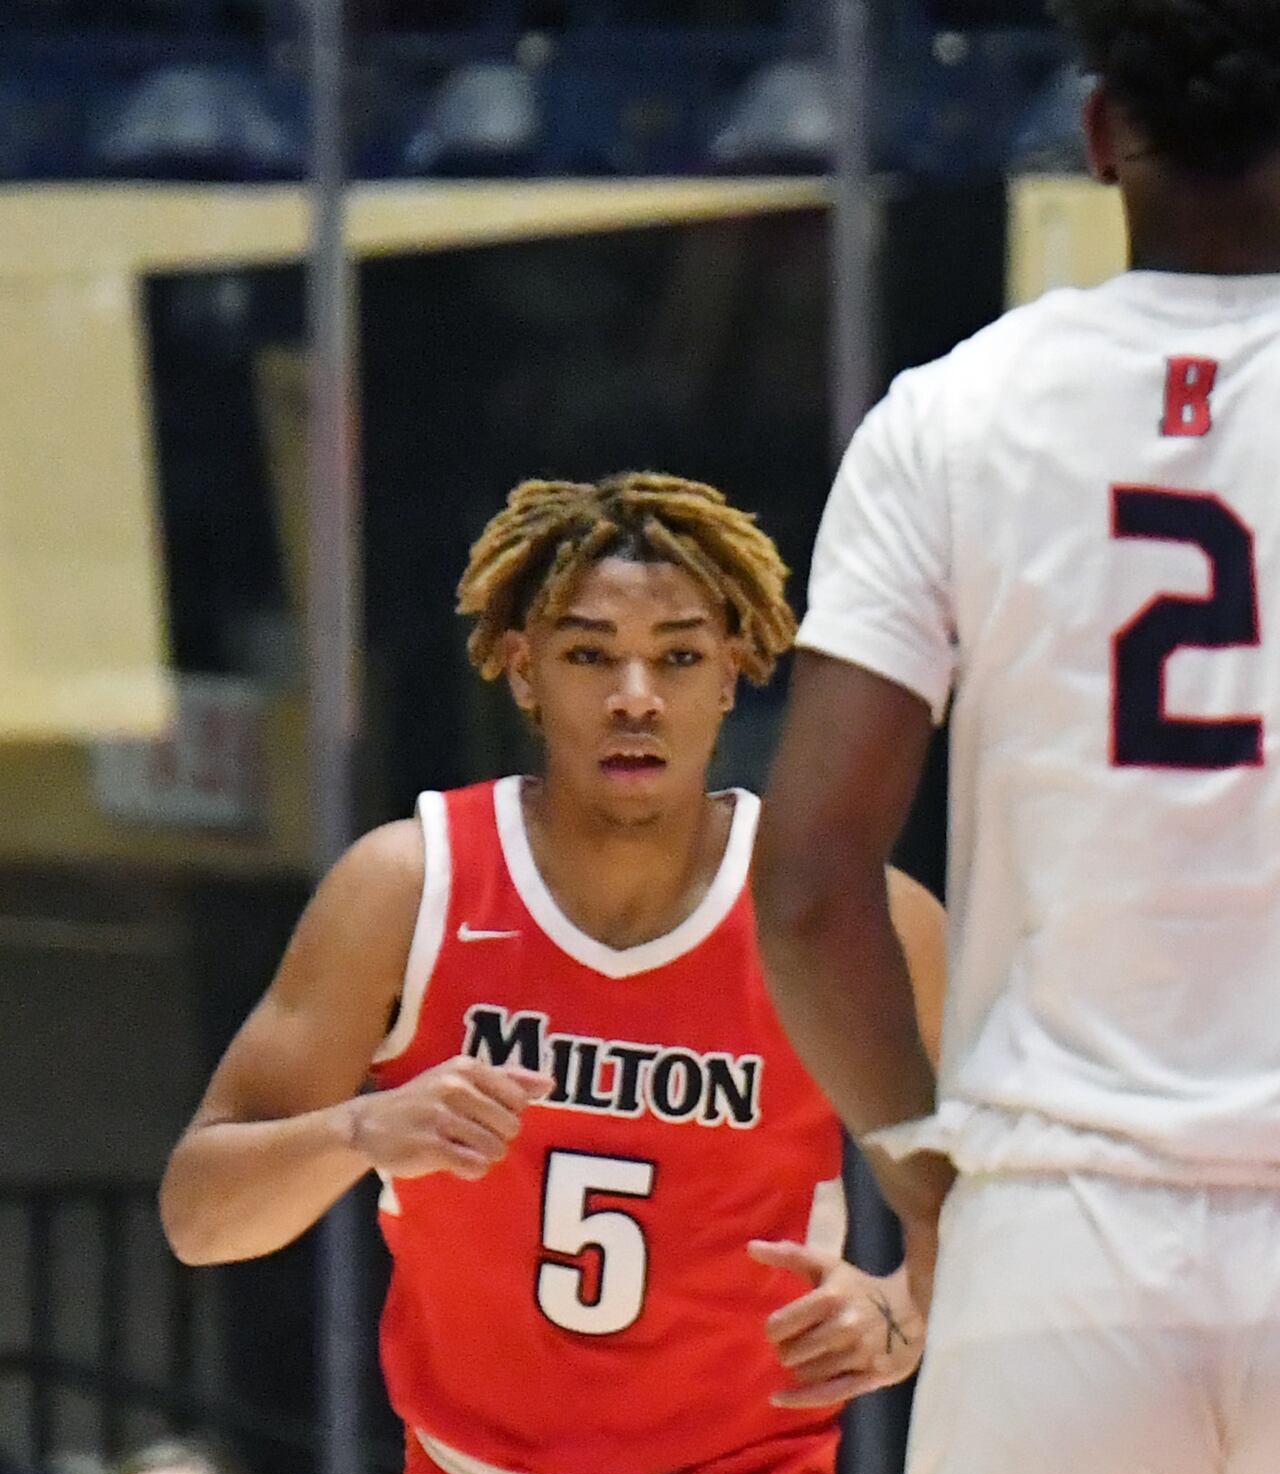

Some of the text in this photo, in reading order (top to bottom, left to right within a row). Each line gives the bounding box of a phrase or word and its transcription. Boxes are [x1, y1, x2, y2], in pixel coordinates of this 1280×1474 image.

[1159, 354, 1219, 438] B
[1109, 481, 1265, 768] 2
[463, 1003, 763, 1129] MILTON
[535, 1148, 657, 1337] 5
